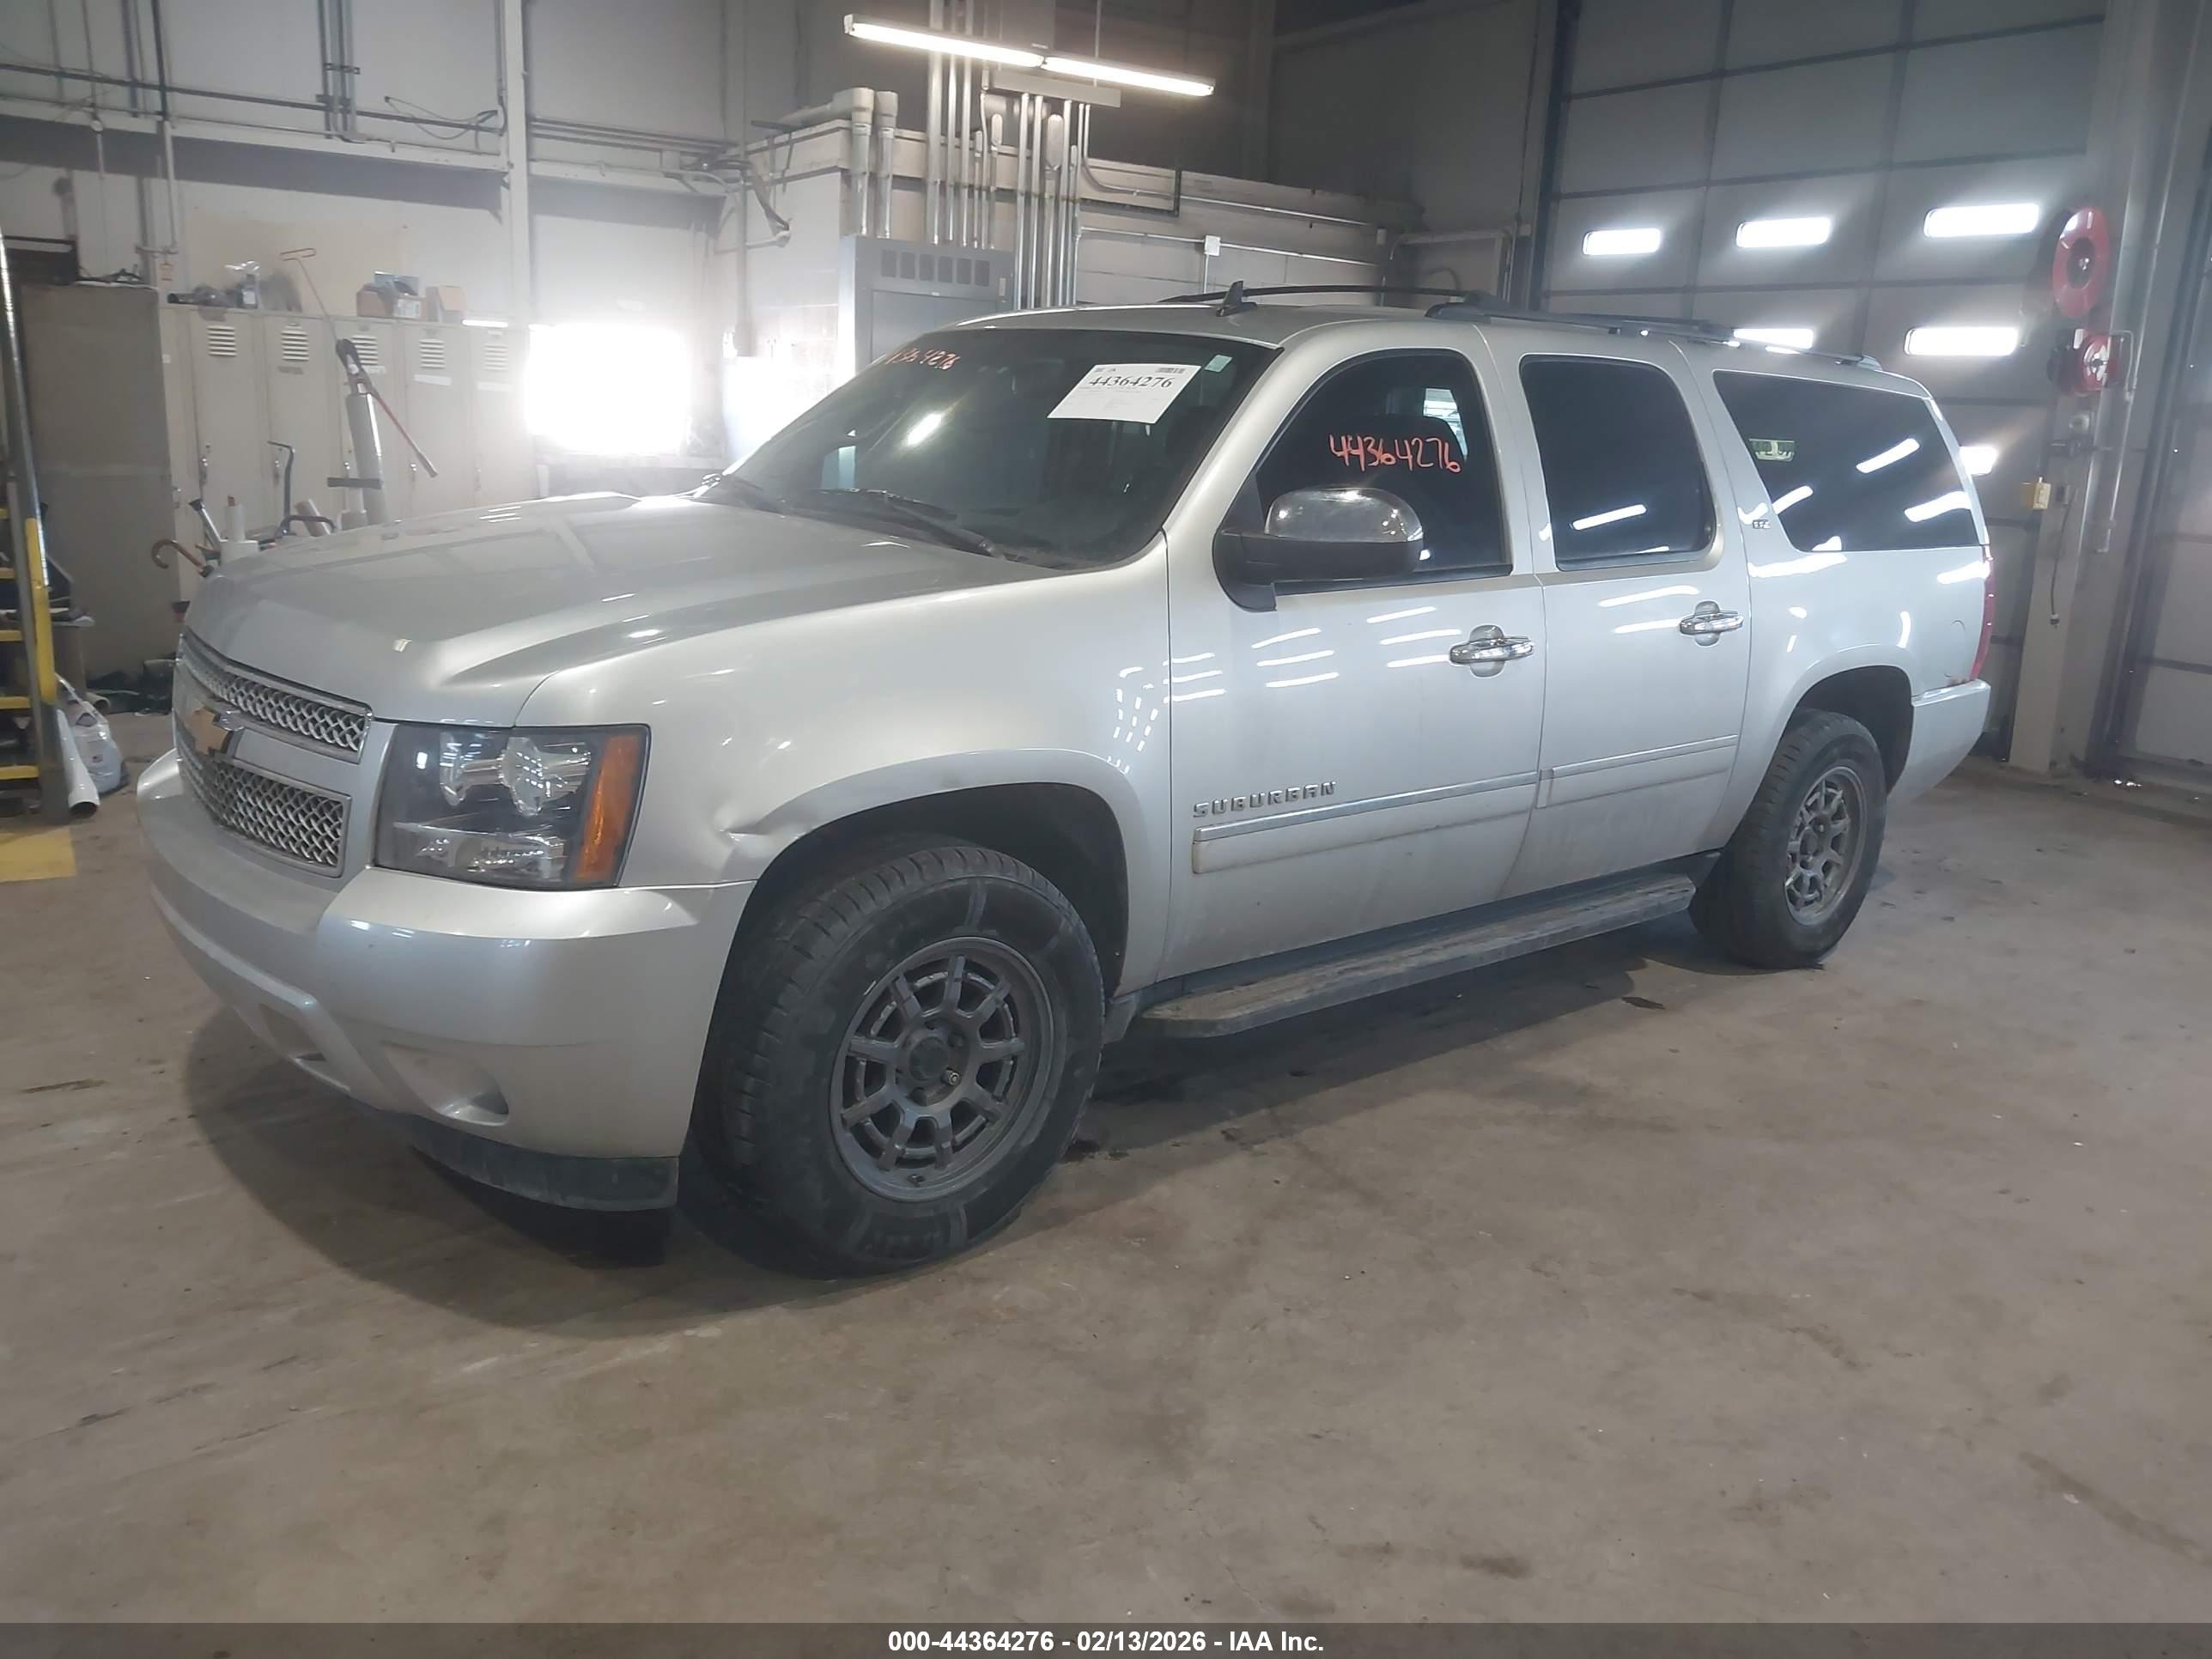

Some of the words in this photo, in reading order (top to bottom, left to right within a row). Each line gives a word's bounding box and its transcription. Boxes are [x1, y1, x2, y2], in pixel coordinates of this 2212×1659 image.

[1089, 376, 1175, 389] 44364276
[1328, 434, 1462, 473] 44364276
[1193, 781, 1337, 818] SUBURBAN
